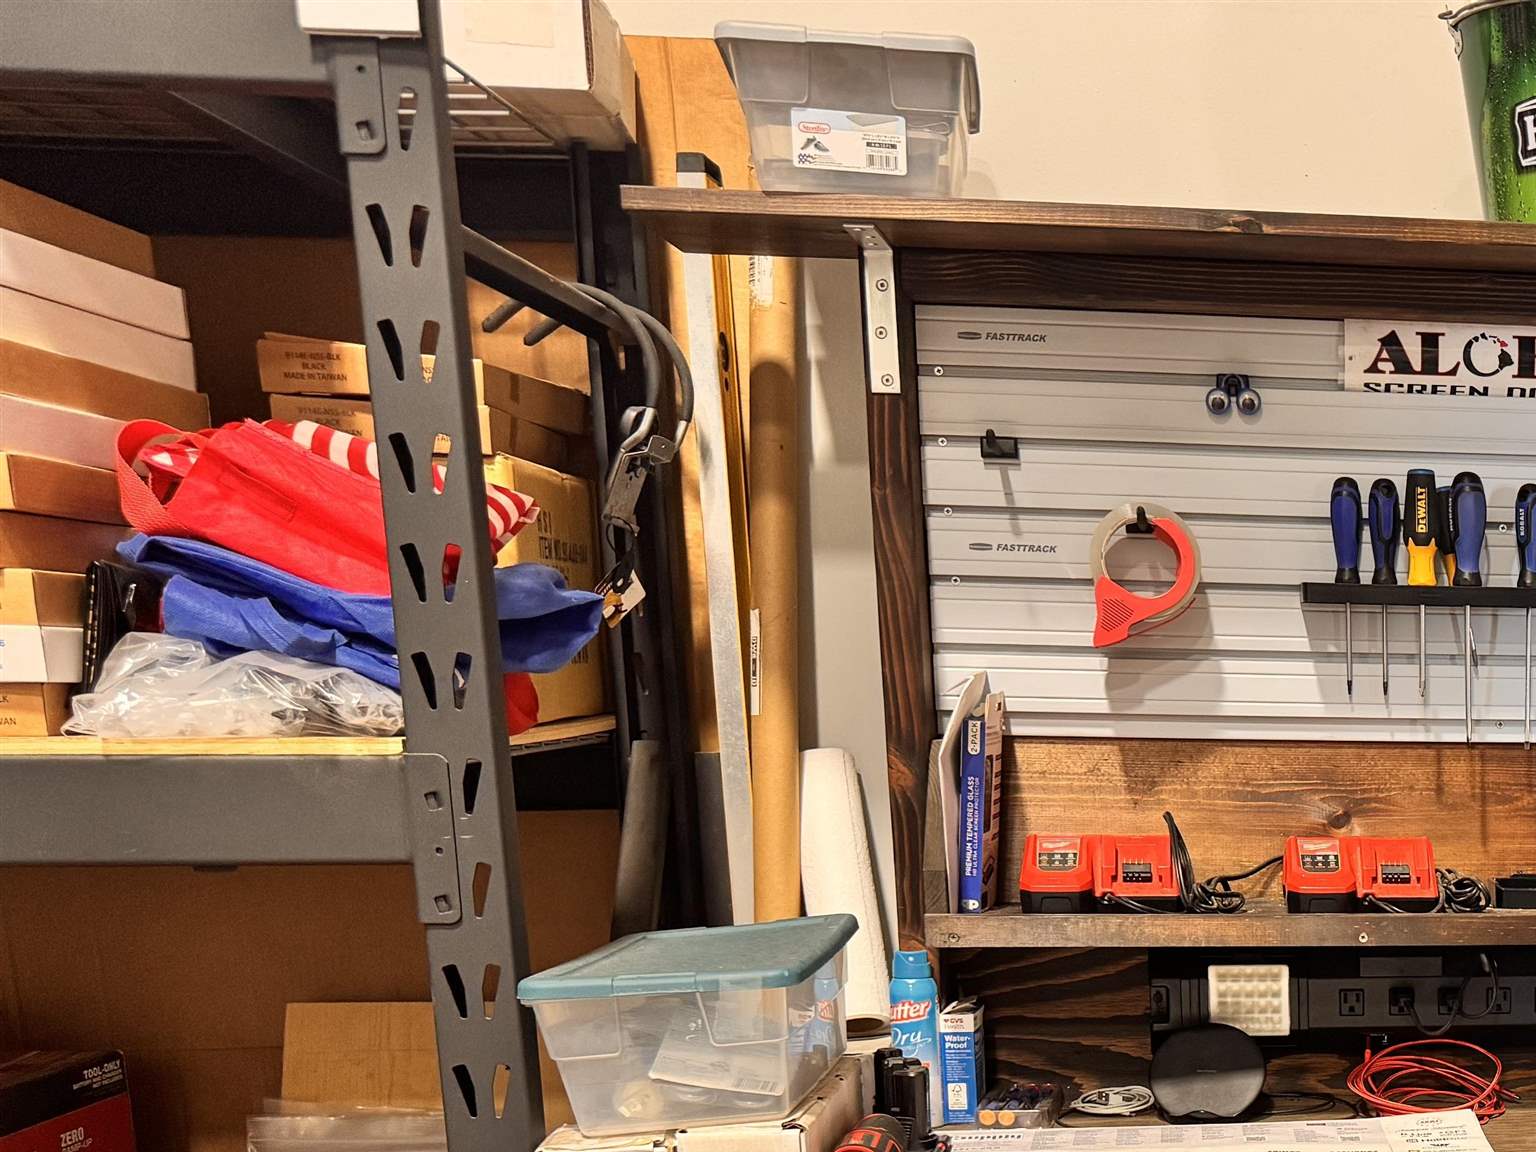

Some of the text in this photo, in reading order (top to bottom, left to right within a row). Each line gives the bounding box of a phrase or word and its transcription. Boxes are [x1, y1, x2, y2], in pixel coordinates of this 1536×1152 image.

[985, 332, 1048, 343] FASTTRACK
[996, 543, 1058, 554] FASTTRACK
[969, 721, 979, 754] 2-PACK
[965, 776, 975, 877] PREMIUM TEMPERED GLASS
[890, 1000, 931, 1020] utter
[944, 1034, 971, 1042] Water-
[945, 1041, 968, 1049] Proof
[83, 1059, 121, 1079] TOOL-ONLY
[60, 1127, 85, 1147] ZERO
